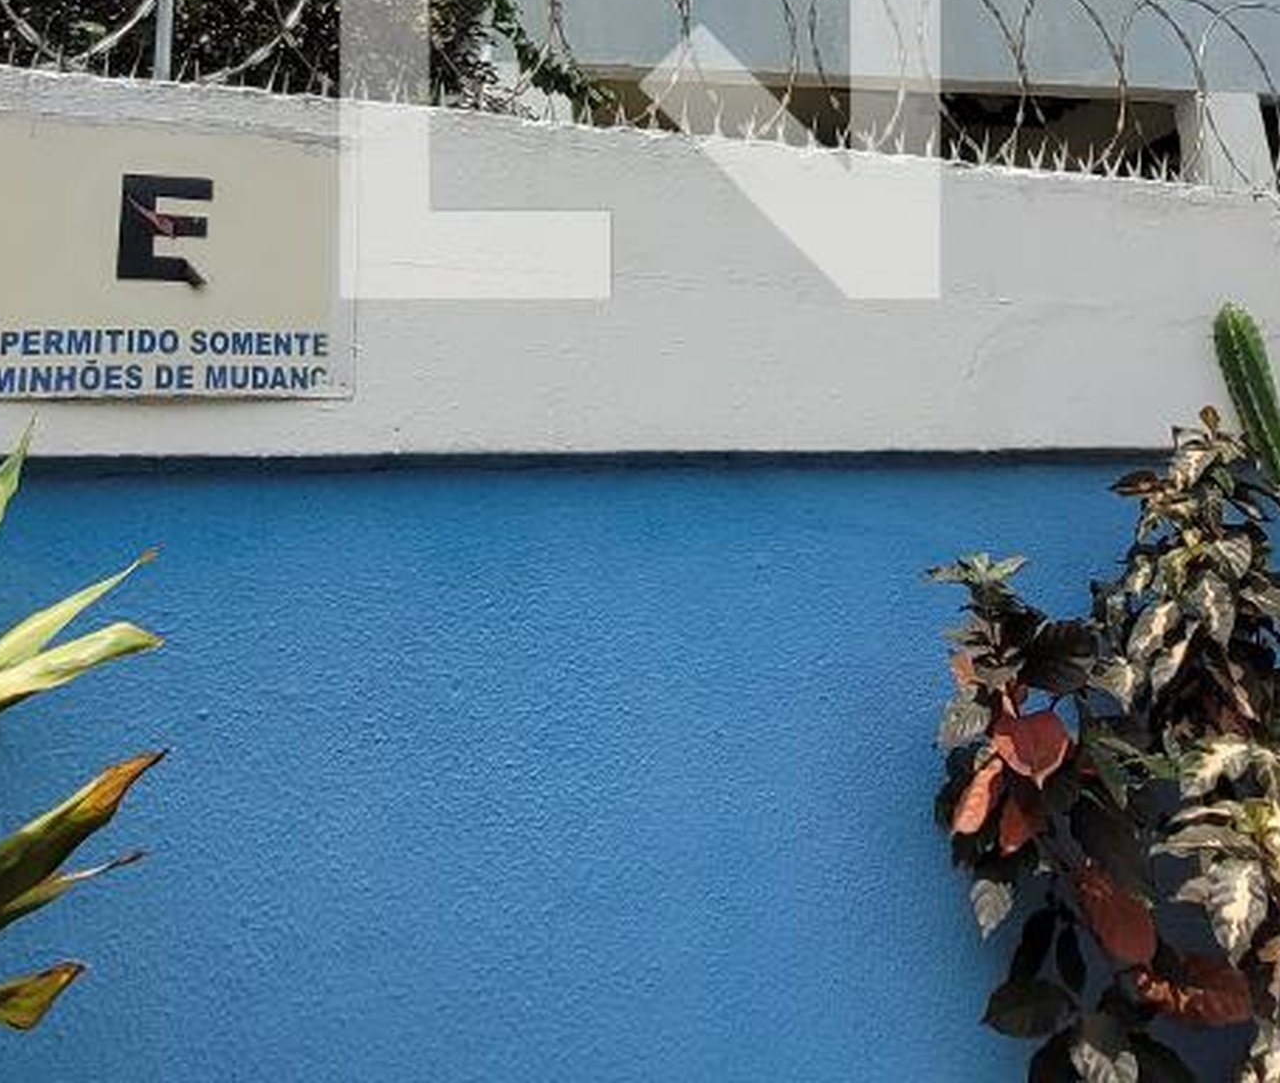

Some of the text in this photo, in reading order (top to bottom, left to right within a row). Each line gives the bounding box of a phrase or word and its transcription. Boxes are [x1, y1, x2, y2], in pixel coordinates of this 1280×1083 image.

[0, 329, 179, 356] PERMITIDO
[190, 329, 329, 357] SOMENTE
[155, 365, 194, 390] DE
